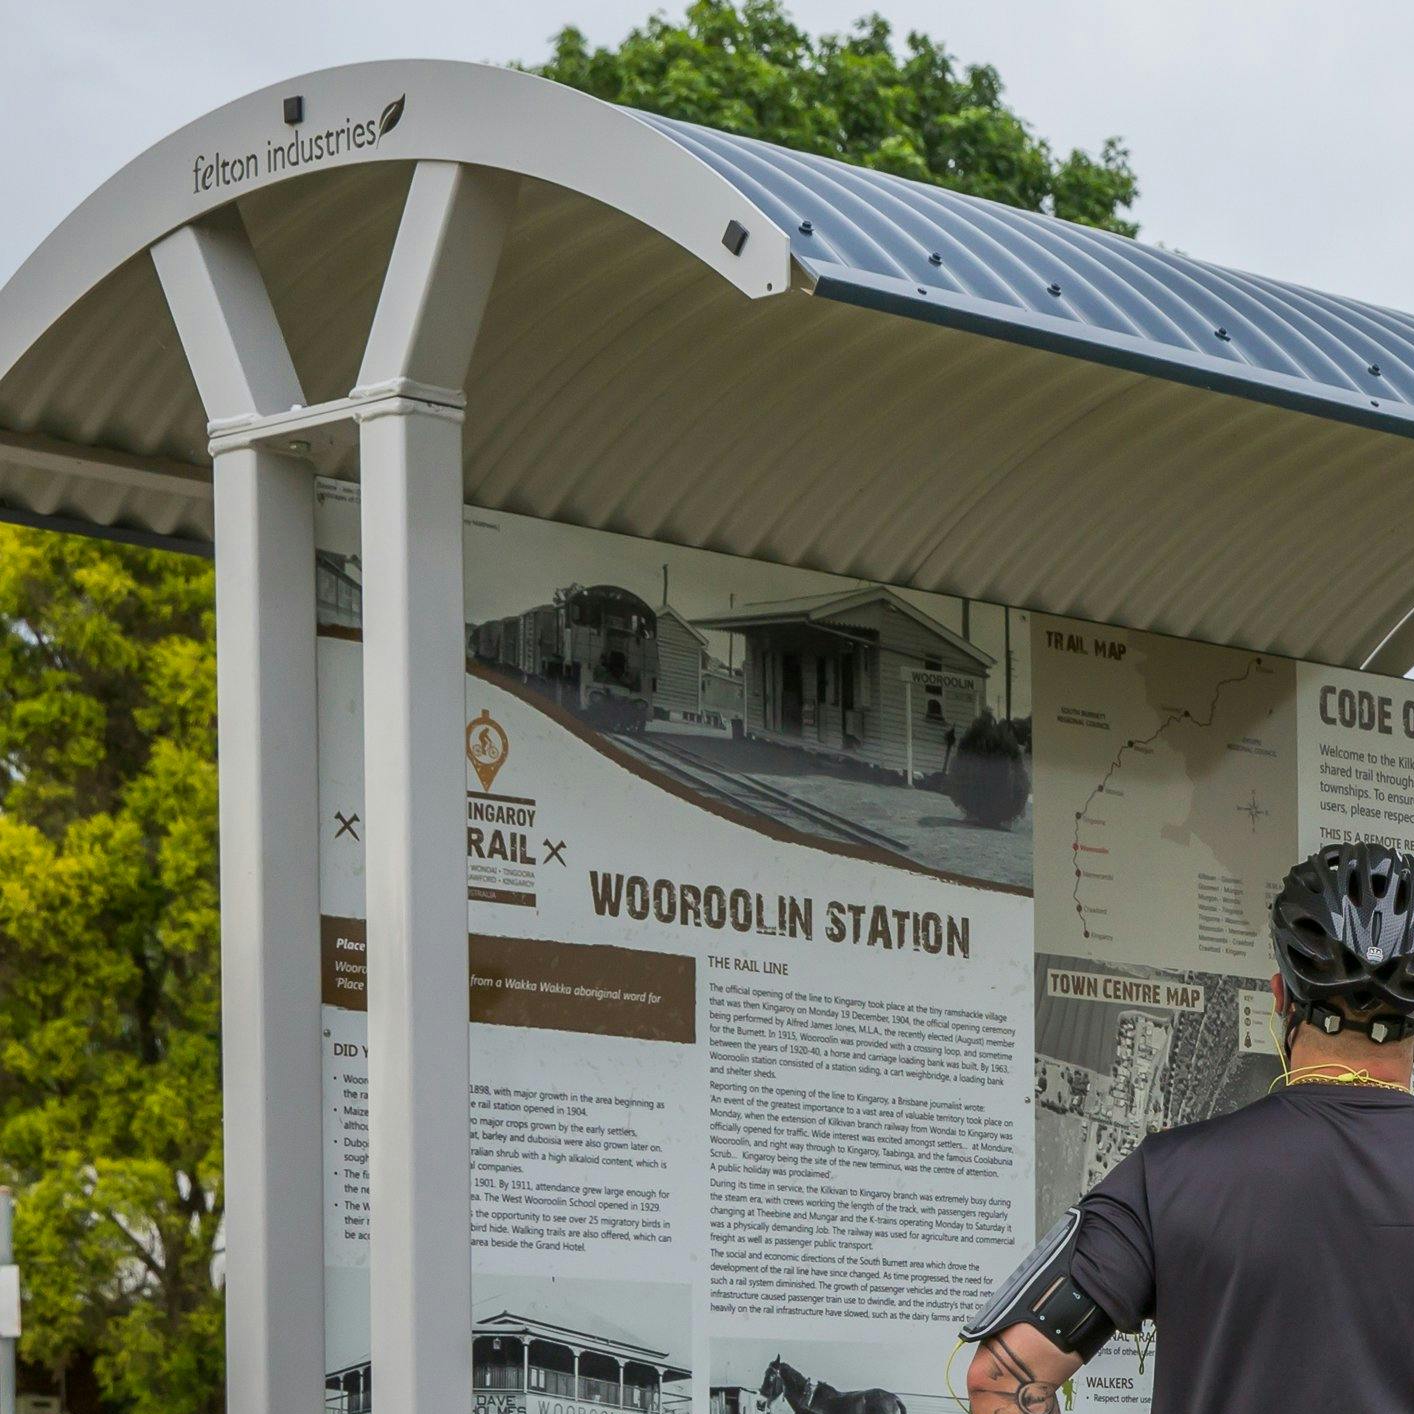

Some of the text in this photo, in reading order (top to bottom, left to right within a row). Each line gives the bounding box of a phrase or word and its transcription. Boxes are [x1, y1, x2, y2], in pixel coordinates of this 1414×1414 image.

[193, 118, 377, 193] felton industries
[1045, 629, 1126, 661] TRAIL MAP
[912, 672, 974, 689] WOOROOLIN
[1319, 684, 1392, 735] CODE
[1318, 742, 1366, 763] Welcome
[1366, 752, 1377, 764] to
[1379, 753, 1396, 768] the
[1319, 760, 1352, 779] shared
[1354, 767, 1373, 781] trail
[1375, 769, 1414, 790] through
[1319, 780, 1371, 801] townships.
[1374, 787, 1386, 802] To
[1319, 800, 1349, 815] users,
[1350, 802, 1381, 819] please
[1319, 826, 1341, 840] THIS
[1343, 830, 1352, 842] IS
[588, 870, 969, 959] WOOROOLIN STATION
[707, 954, 788, 976] THE RAIL LINE
[494, 979, 502, 988] a
[504, 977, 537, 991] Wakka
[539, 981, 571, 994] Wakka
[573, 985, 621, 1001] aboriginal
[622, 991, 646, 1002] word
[647, 991, 661, 1004] for
[1050, 972, 1200, 1008] TOWN CENTRE MAP
[708, 982, 1007, 1024] The official opening of the line to Kingaroy took place at the tiny ramshackle village
[333, 1042, 358, 1057] DID
[492, 1086, 511, 1098] with
[513, 1089, 537, 1101] major
[538, 1091, 568, 1102] growth
[570, 1092, 578, 1101] in
[579, 1092, 593, 1103] the
[594, 1096, 612, 1105] area
[613, 1094, 654, 1110] beginning
[655, 1101, 665, 1109] as
[1086, 1376, 1133, 1390] WALKERS
[476, 1395, 518, 1407] DAVE
[1093, 1393, 1119, 1404] Respect
[1120, 1394, 1138, 1403] other
